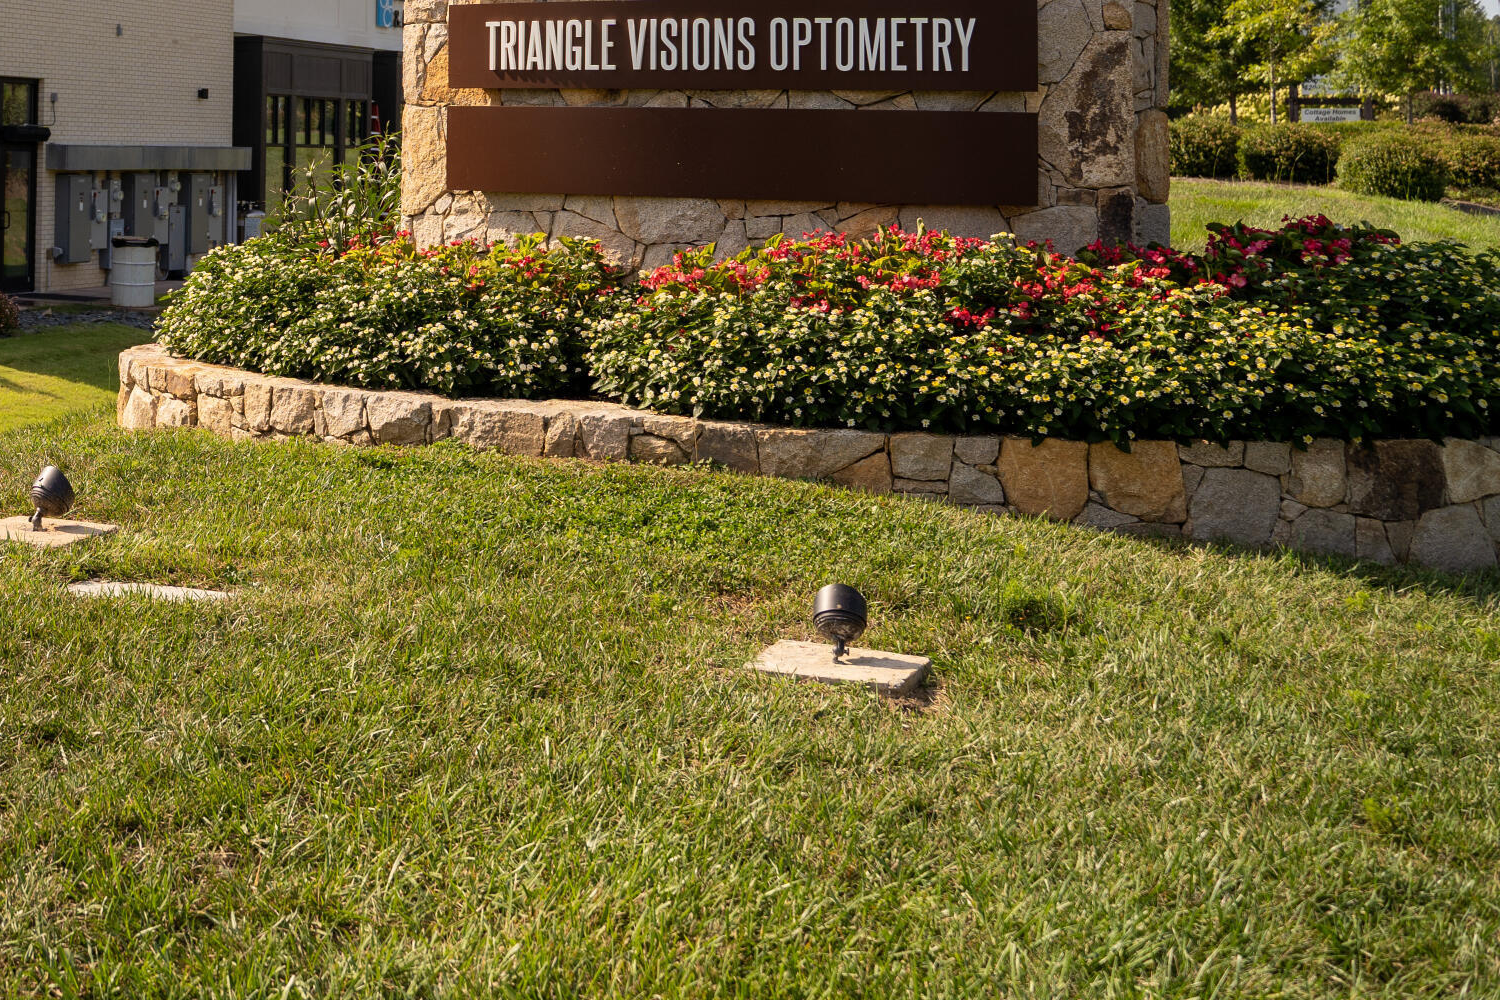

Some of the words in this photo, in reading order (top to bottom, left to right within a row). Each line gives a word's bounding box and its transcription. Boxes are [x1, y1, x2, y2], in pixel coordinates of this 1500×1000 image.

[486, 18, 617, 71] TRIANGLE
[627, 17, 755, 71] VISIONS
[769, 17, 976, 72] OPTOMETRY
[1304, 109, 1331, 117] Cottage
